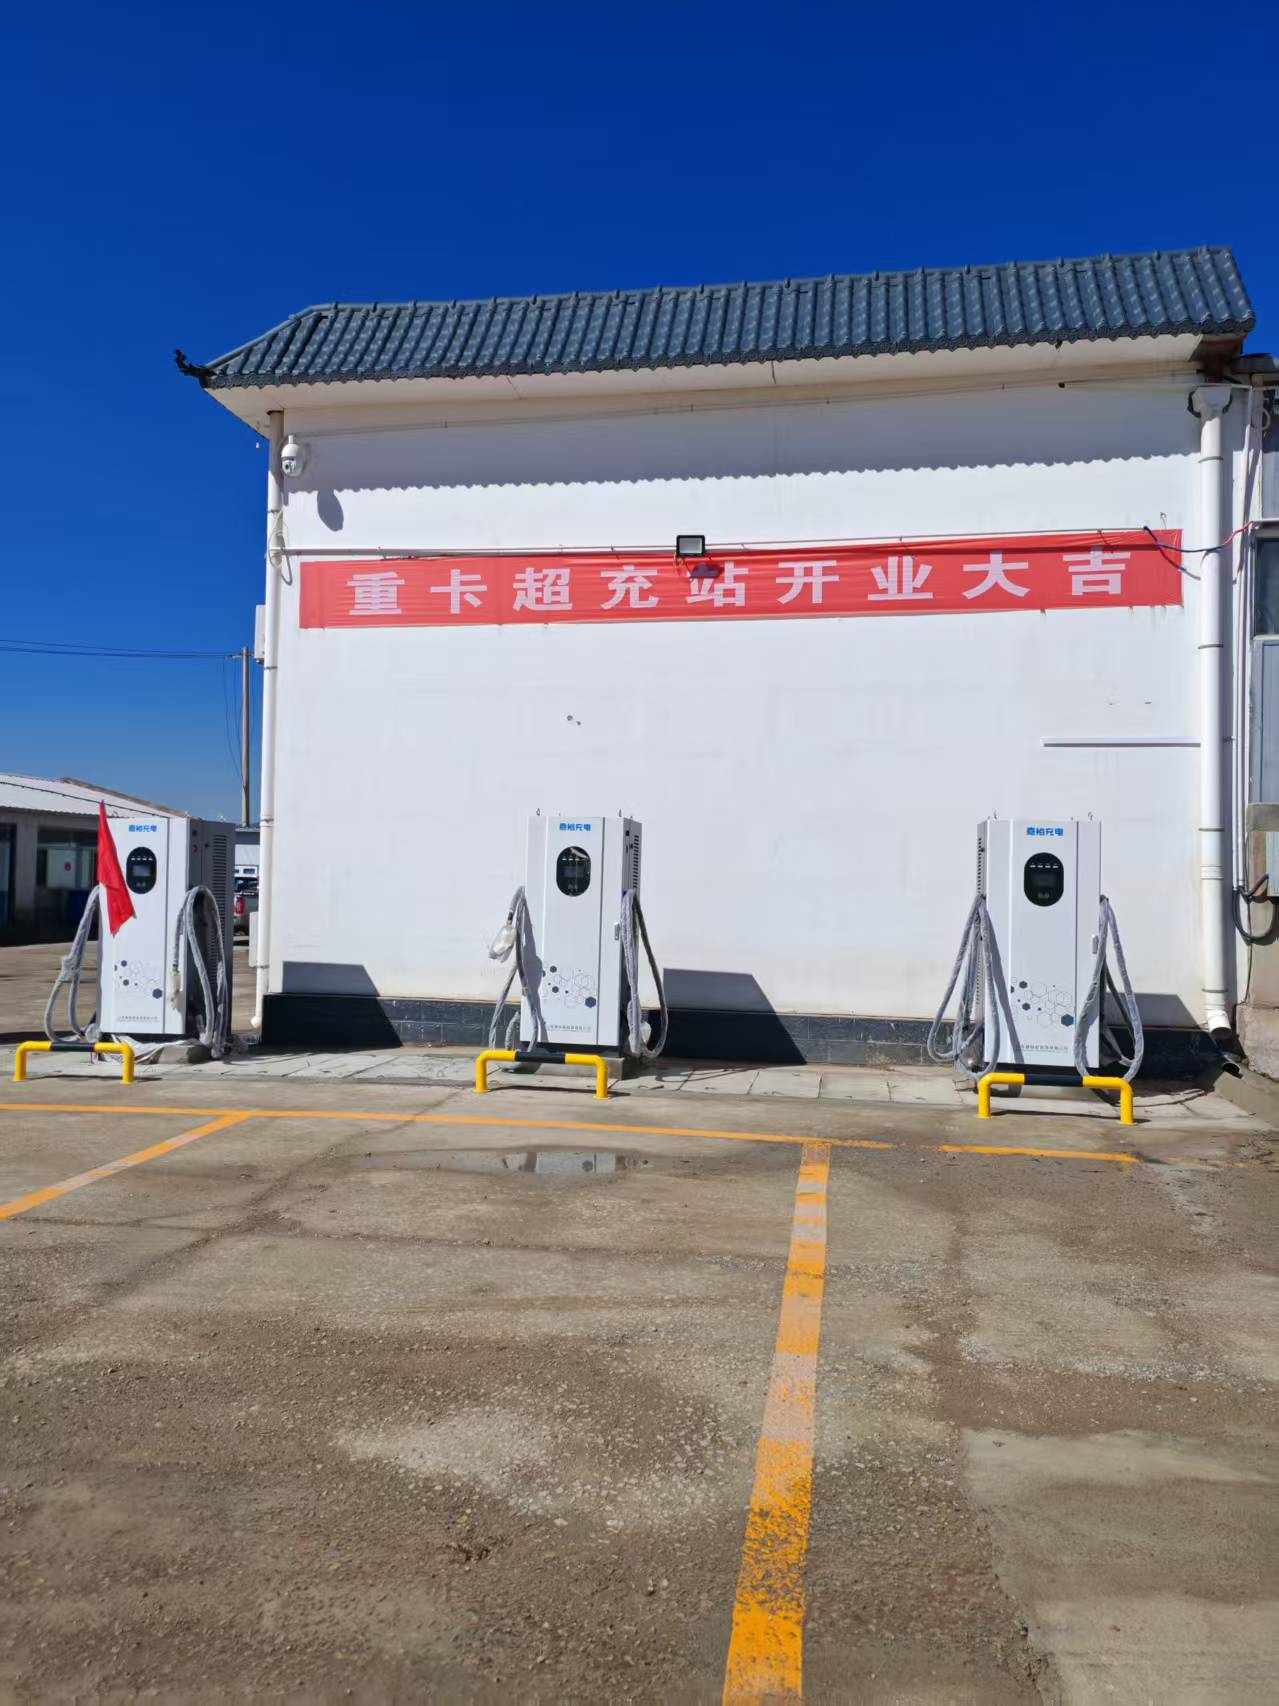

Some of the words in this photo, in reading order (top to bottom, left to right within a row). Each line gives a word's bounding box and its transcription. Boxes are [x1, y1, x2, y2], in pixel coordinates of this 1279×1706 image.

[346, 547, 1131, 616] 重卡超充站开业大吉
